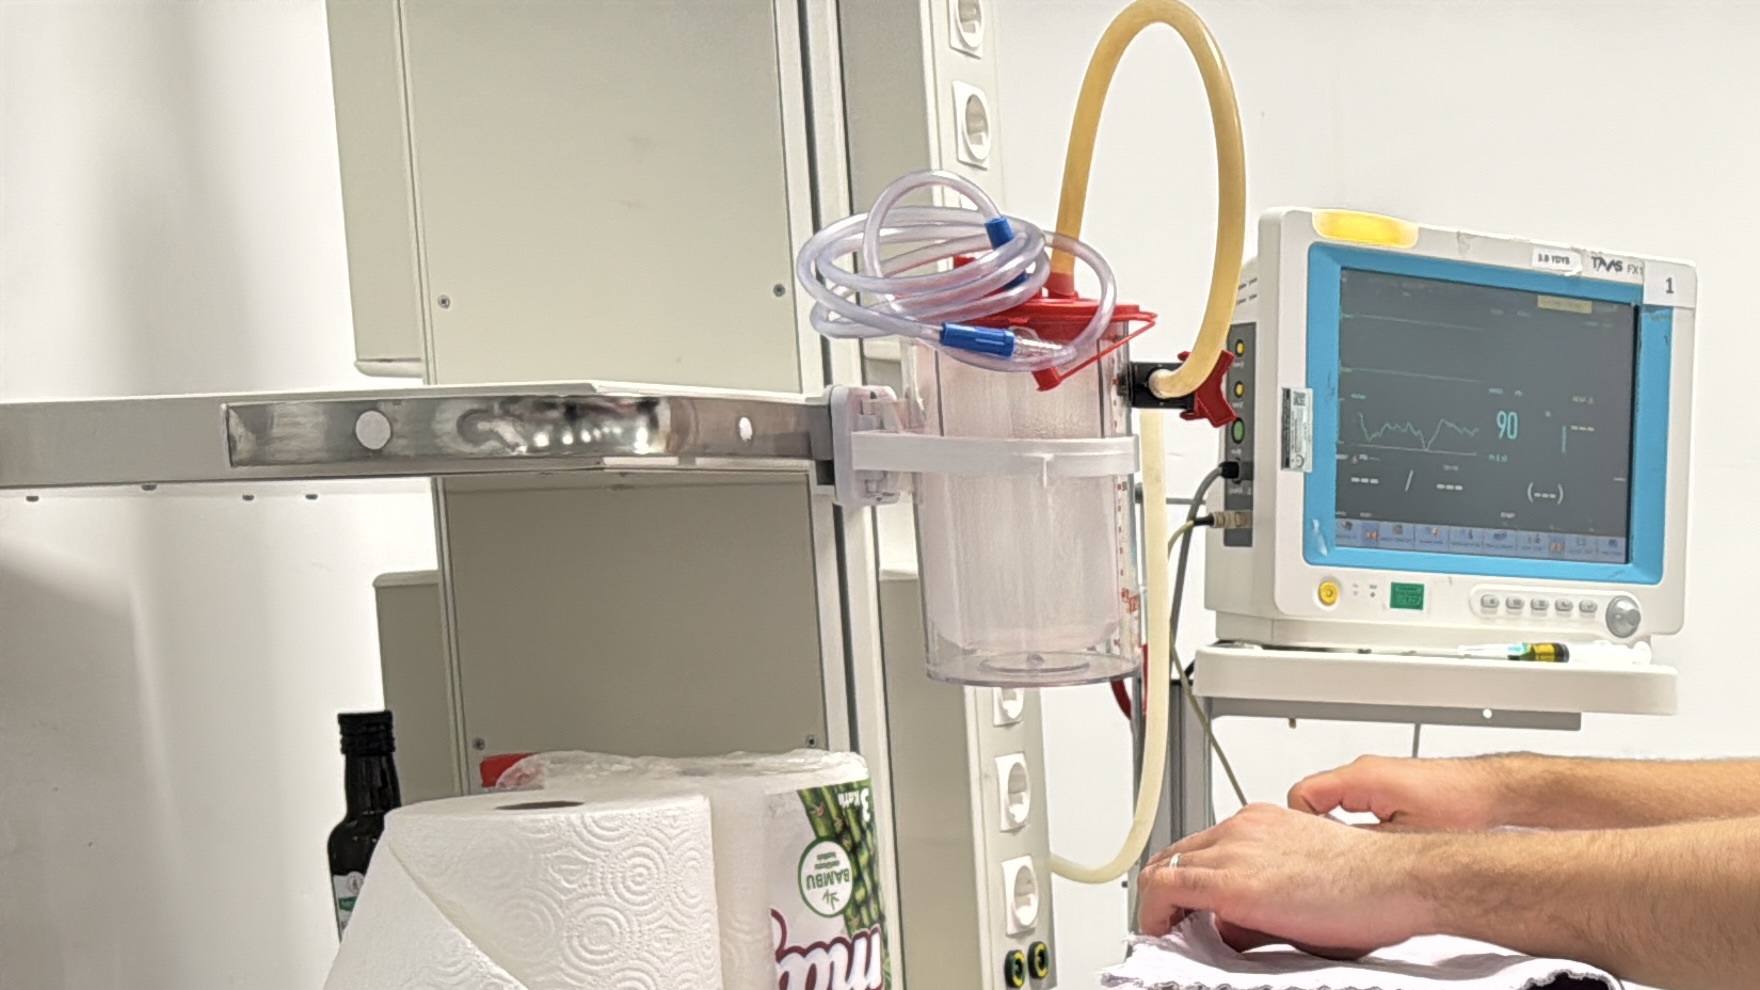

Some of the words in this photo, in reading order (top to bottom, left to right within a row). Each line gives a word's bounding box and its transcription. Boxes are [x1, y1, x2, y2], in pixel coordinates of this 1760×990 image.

[1665, 277, 1674, 294] 1
[1496, 410, 1519, 440] 90
[860, 788, 872, 822] 3
[805, 868, 850, 890] BAMBU
